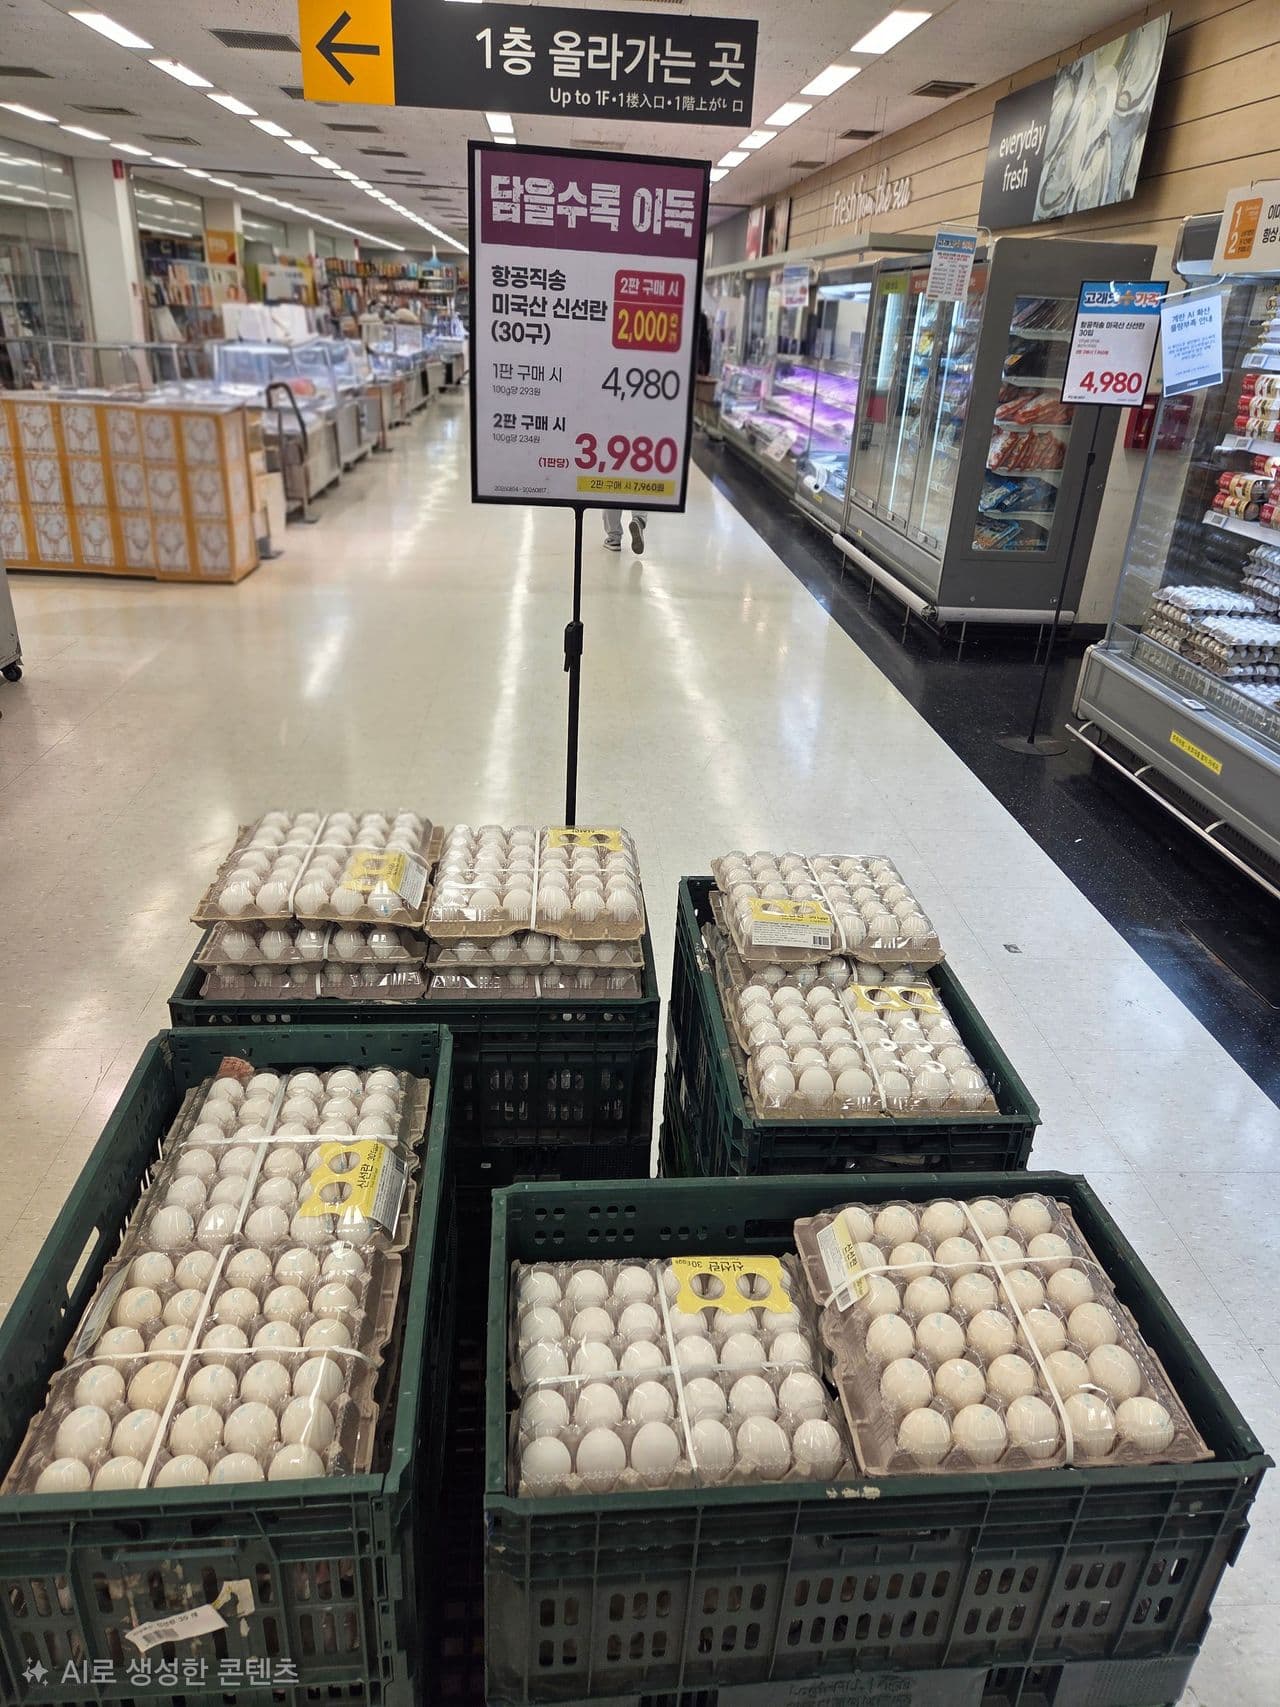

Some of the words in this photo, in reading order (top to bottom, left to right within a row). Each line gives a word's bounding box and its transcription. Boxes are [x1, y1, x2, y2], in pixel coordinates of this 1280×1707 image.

[475, 26, 535, 76] 1층
[549, 30, 696, 84] 올라가는
[709, 42, 745, 88] 곳
[550, 87, 571, 108] Up
[575, 89, 591, 105] to
[1000, 120, 1047, 160] everyday
[1002, 160, 1028, 192] fresh
[490, 174, 621, 231] 담을수록
[632, 187, 696, 237] 이득
[492, 265, 566, 291] 항공직송
[620, 277, 640, 294] 2판
[642, 279, 665, 296] 구매
[668, 280, 679, 297] 시
[492, 293, 548, 318] 미국산
[552, 298, 608, 322] 신선란
[491, 320, 551, 345] (30구)
[493, 363, 514, 380] 1판
[517, 365, 545, 381] 구매
[549, 366, 562, 383] 시
[601, 366, 681, 401] 4,980
[1080, 371, 1143, 394] 4,980
[493, 413, 517, 429] 2판
[521, 415, 549, 431] 구매
[553, 417, 566, 432] 시
[538, 456, 570, 469] (1판당)
[574, 433, 679, 474] 3,980
